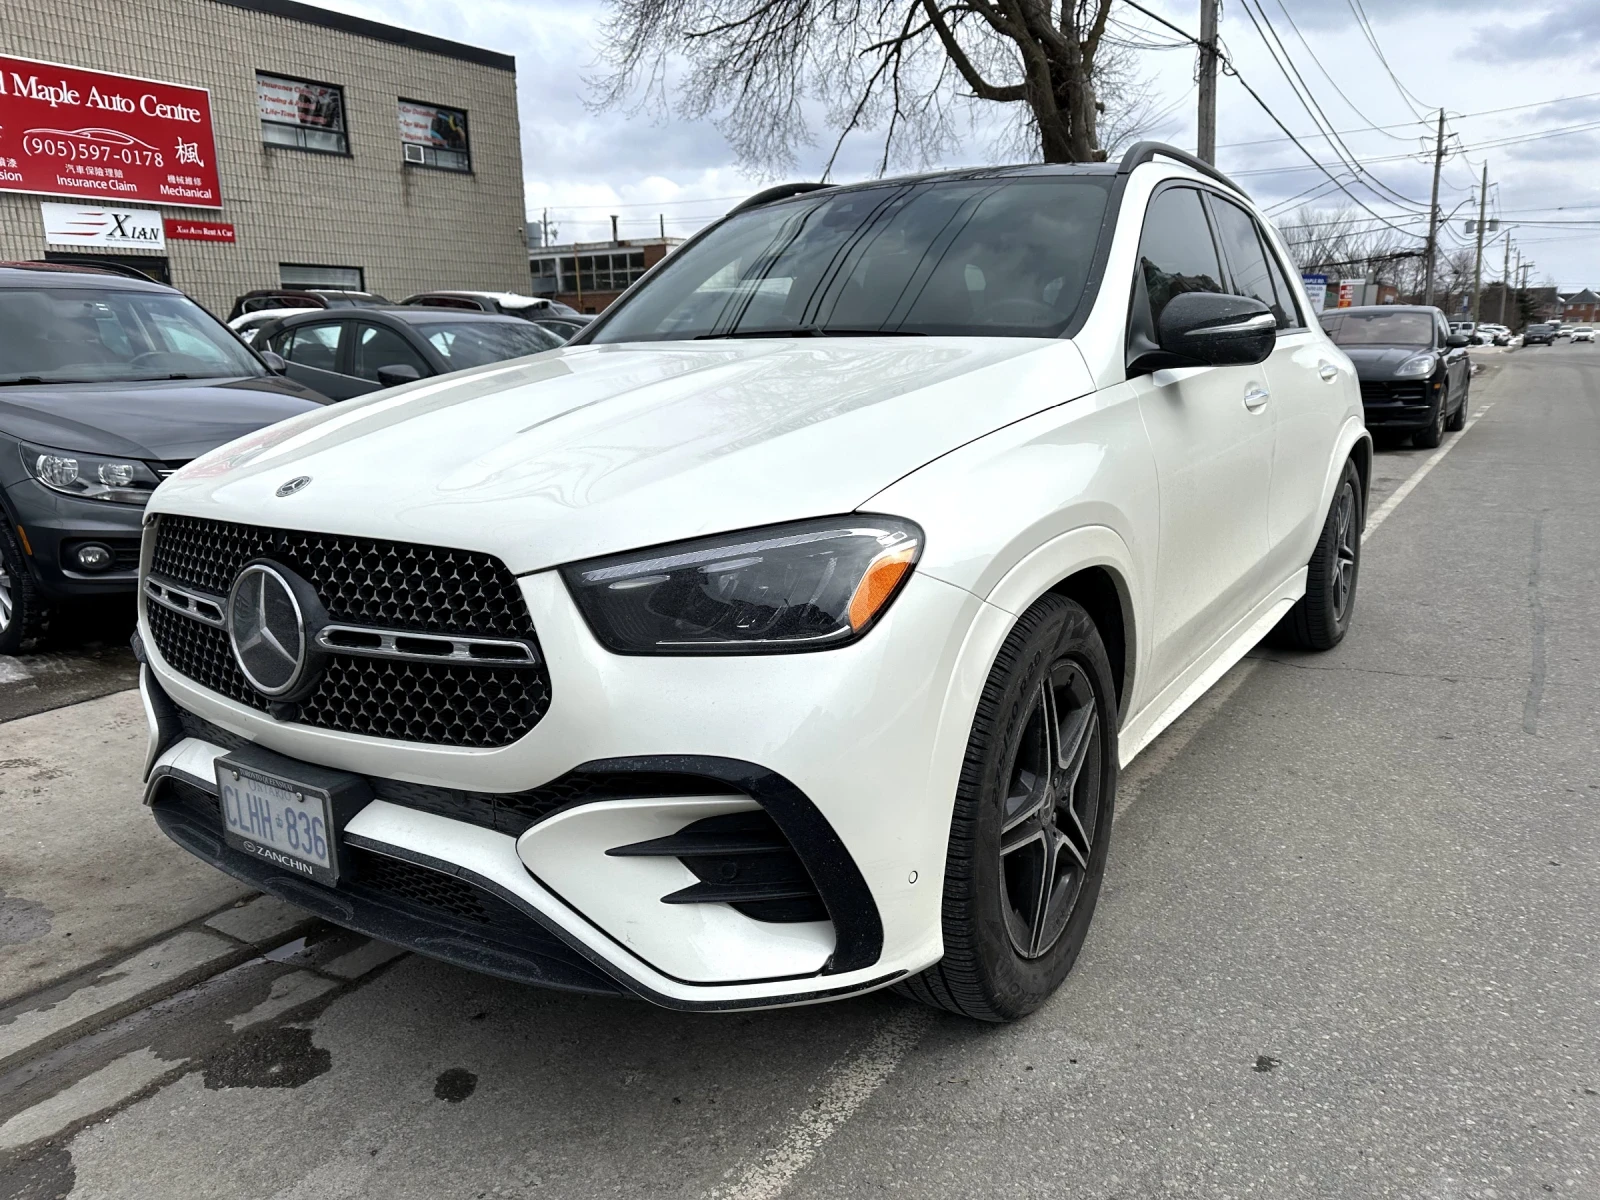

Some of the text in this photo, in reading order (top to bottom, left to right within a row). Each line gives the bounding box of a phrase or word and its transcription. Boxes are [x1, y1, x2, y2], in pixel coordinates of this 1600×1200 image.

[10, 72, 80, 107] Maple
[85, 86, 135, 113] Auto
[140, 94, 201, 123] Centre
[23, 135, 164, 167] (905)597-0178
[174, 136, 204, 168] 楓
[57, 174, 138, 193] Insurance Claim
[160, 184, 212, 199] Mechanical
[248, 779, 292, 801] ONTARIO
[223, 785, 326, 860] CLHH 836
[257, 845, 313, 875] ZANCHIN
